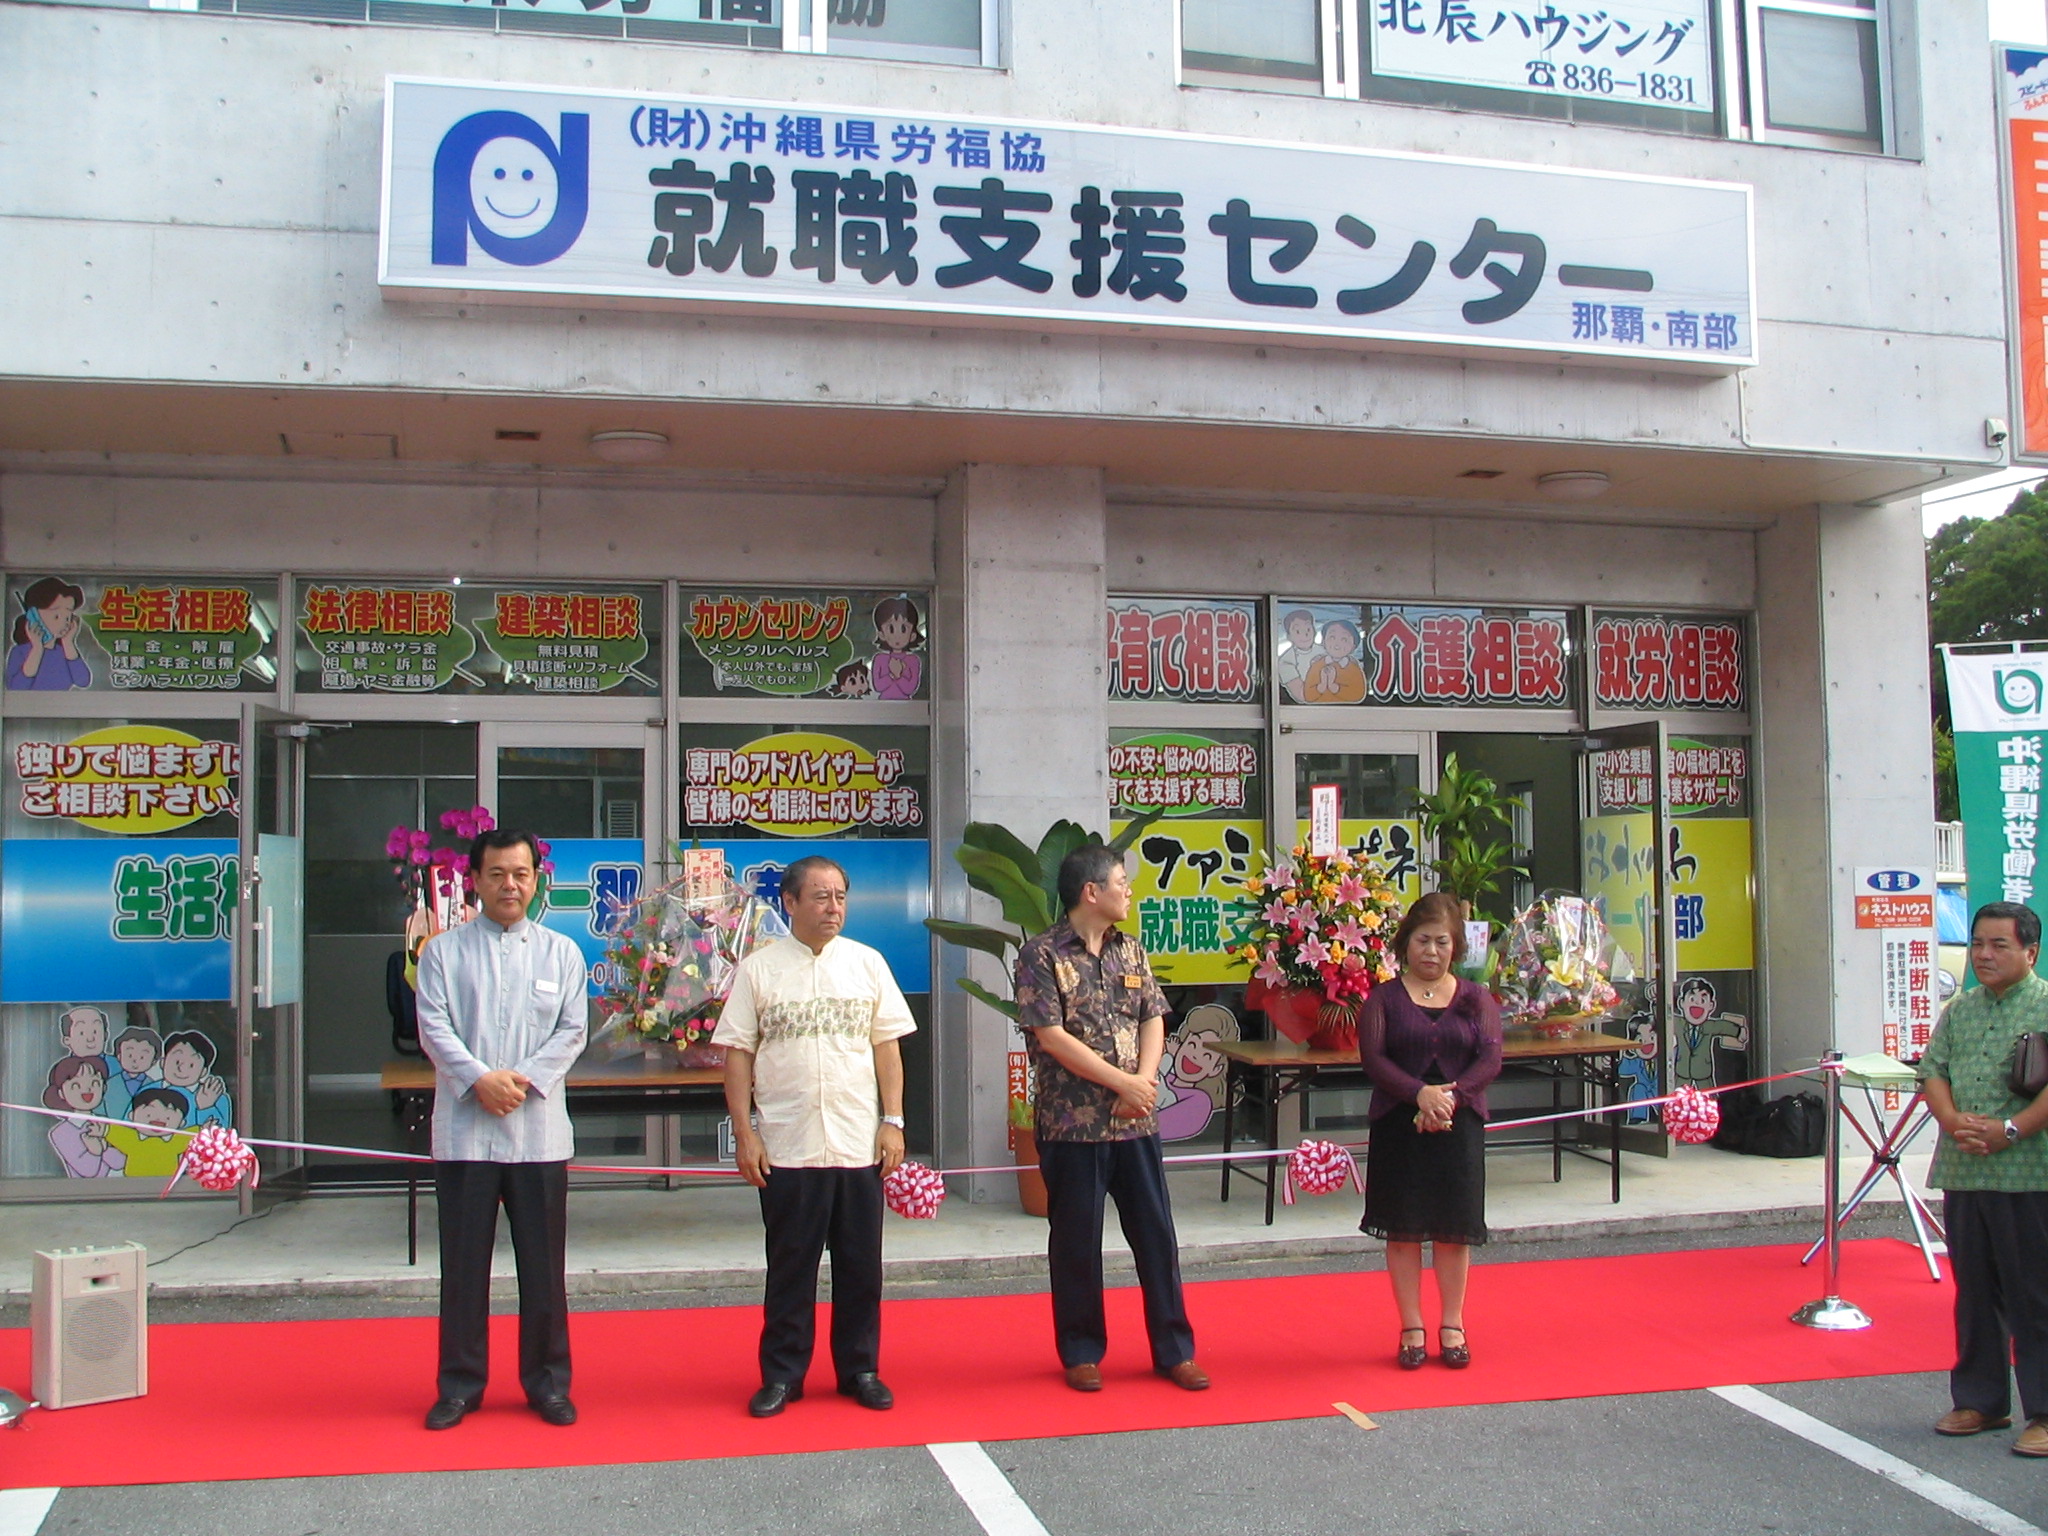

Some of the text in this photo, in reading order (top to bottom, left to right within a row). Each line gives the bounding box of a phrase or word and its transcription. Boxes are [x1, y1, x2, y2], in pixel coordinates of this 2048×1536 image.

[1378, 0, 1694, 64] 北辰ハウジング
[1563, 64, 1696, 104] 836-1831
[629, 105, 1047, 174] (財)沖縄県労福協
[648, 158, 1654, 325] 就職支援センター
[1572, 302, 1738, 350] 那覇・南部
[101, 587, 250, 634] 生活相談
[306, 589, 452, 635] 法律相談
[497, 595, 640, 639] 建築相談
[693, 597, 848, 641] カウンセリング
[325, 640, 438, 655] 交通事故・サラ金
[537, 644, 599, 659] 無料見積
[708, 643, 830, 657] メンタルヘルス
[1372, 613, 1565, 698] 介護相談
[1597, 622, 1741, 702] 就労相談
[537, 675, 600, 690] 建築相談
[688, 749, 902, 785] 専門のアドバイザーが
[1110, 746, 1255, 773] の不安・悩みの相談と
[22, 783, 240, 817] ご相談下さい。
[688, 787, 922, 824] 皆様のご相談に応じます。
[1877, 873, 1912, 889] 管理
[1139, 896, 1262, 953] 就職支
[1674, 893, 1704, 940] 部
[1871, 902, 1930, 917] ネストハウス
